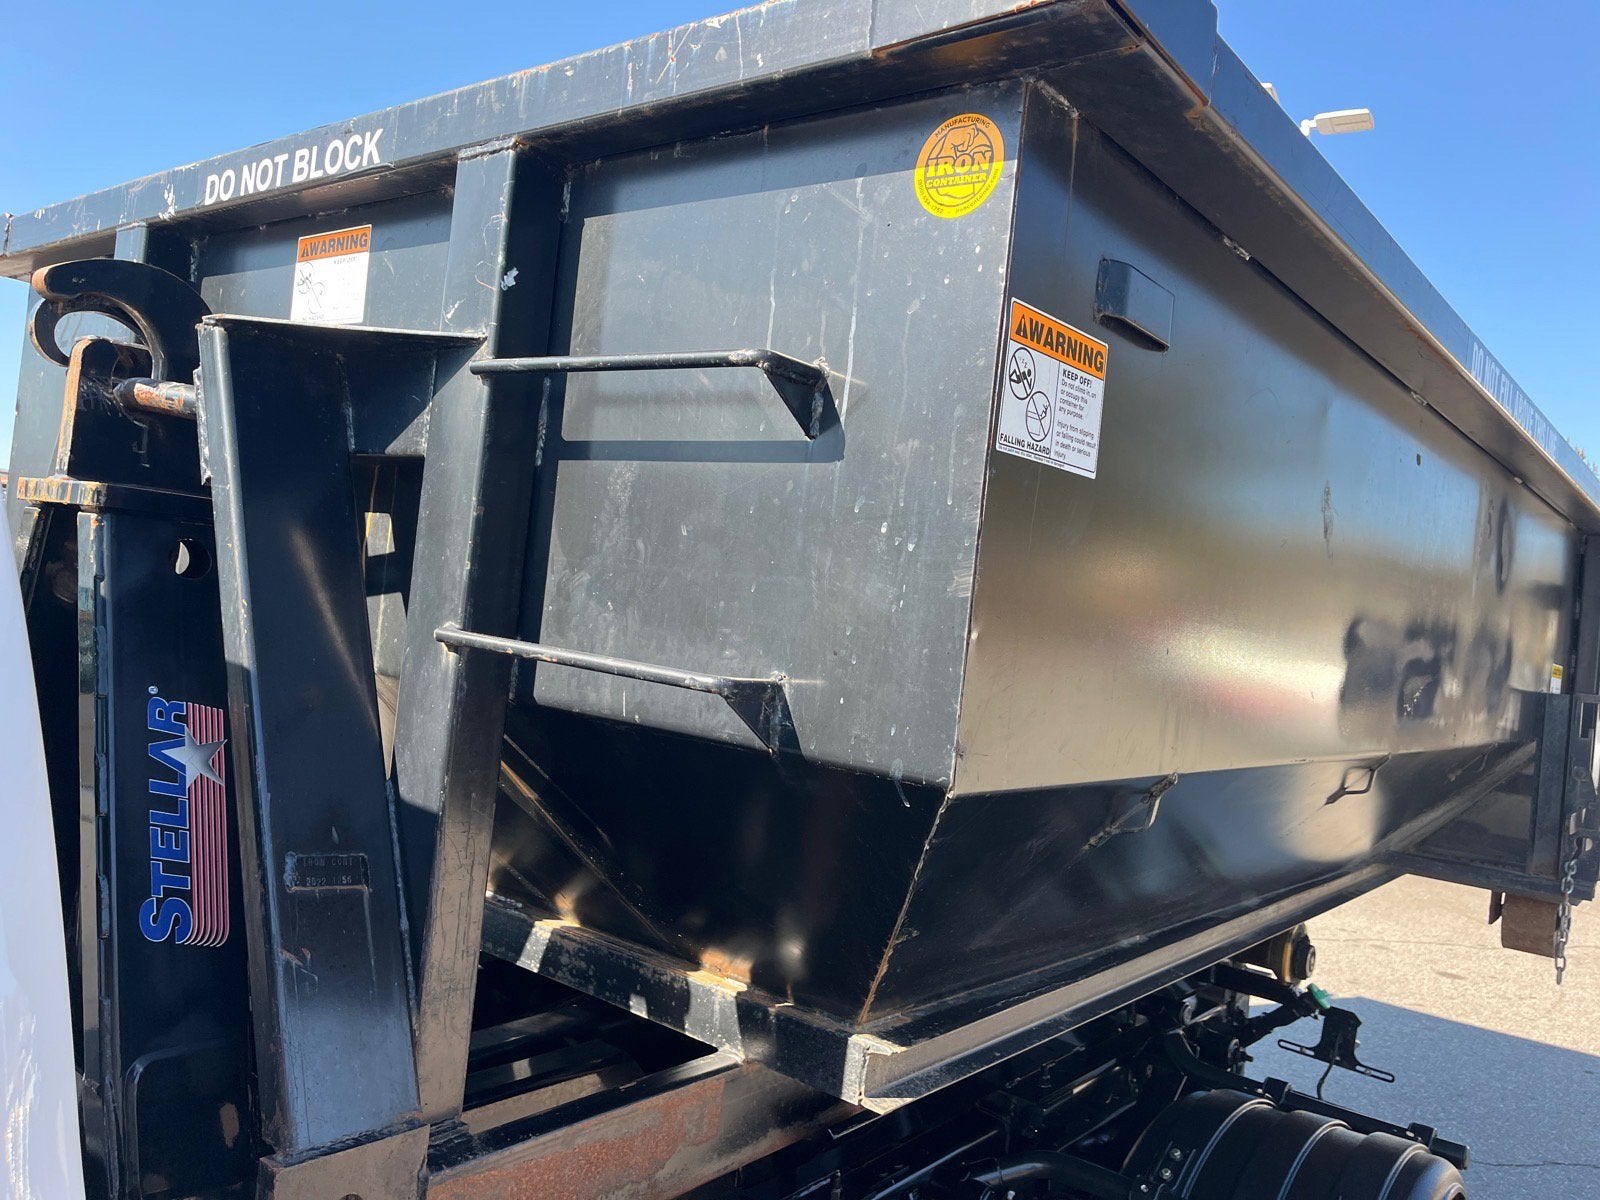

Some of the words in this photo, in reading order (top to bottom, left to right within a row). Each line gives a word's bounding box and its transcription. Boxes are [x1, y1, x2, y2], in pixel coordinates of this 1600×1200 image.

[935, 117, 990, 137] MANUFACTURING
[204, 169, 236, 205] DO
[239, 153, 289, 196] NOT
[292, 128, 384, 183] BLOCK
[926, 151, 992, 178] IRON
[925, 173, 987, 188] CONTAINER
[310, 233, 368, 256] WARNING
[1029, 317, 1104, 373] WARNING
[1061, 379, 1067, 387] Do
[1075, 384, 1085, 395] climb
[1062, 368, 1078, 382] KEEP
[1079, 376, 1092, 388] OFF!
[1471, 342, 1484, 381] DO
[1484, 355, 1500, 398] NOT
[1500, 373, 1513, 414] FILL
[1059, 397, 1078, 408] container
[1065, 391, 1080, 402] occupy
[1080, 396, 1088, 405] this
[1058, 406, 1066, 414] any
[1061, 432, 1074, 444] falling
[1074, 437, 1085, 446] could
[1086, 440, 1096, 450] result
[1069, 424, 1078, 433] from
[1079, 426, 1094, 440] slipping
[1000, 433, 1025, 448] FALLING
[1026, 440, 1050, 455] HAZARD
[1060, 441, 1071, 450] death
[1077, 448, 1091, 457] serious
[139, 696, 193, 944] STELLAR
